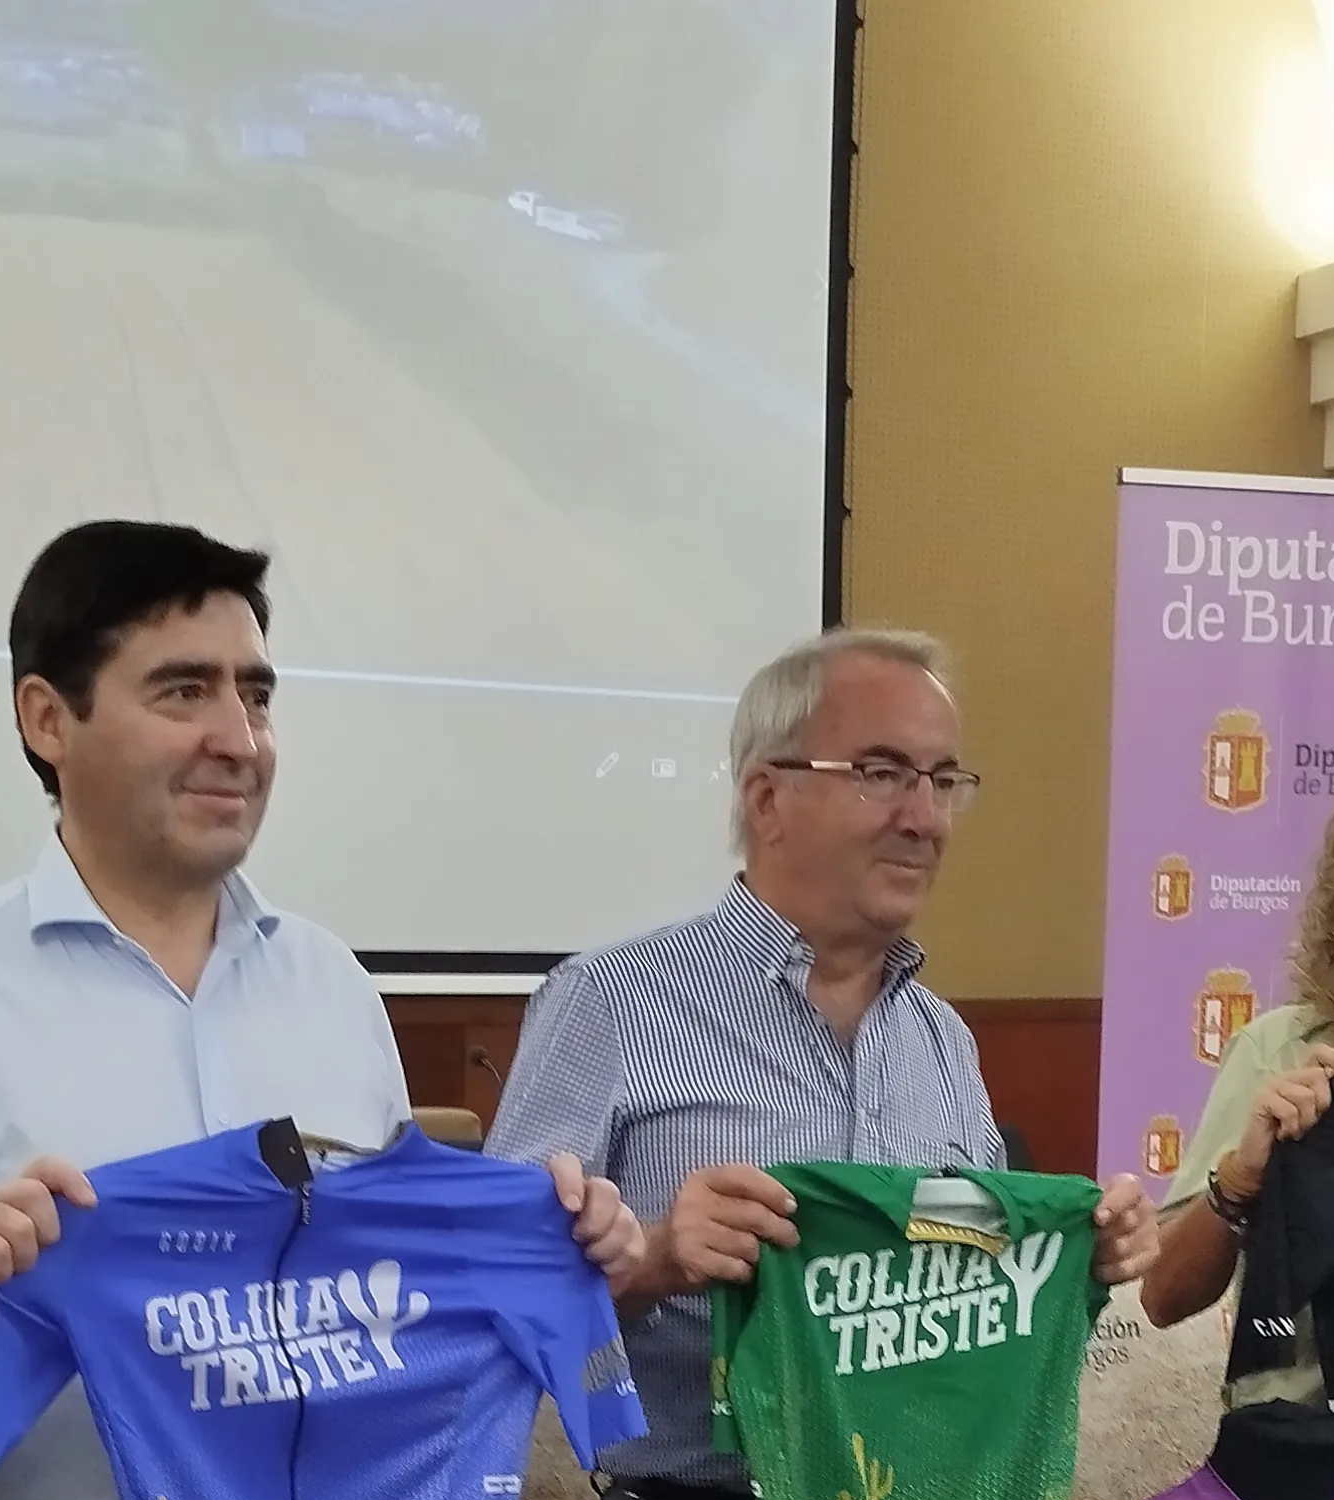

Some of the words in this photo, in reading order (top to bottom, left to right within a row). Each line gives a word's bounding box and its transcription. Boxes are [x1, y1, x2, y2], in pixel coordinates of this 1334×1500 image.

[1162, 585, 1224, 642] de
[1293, 771, 1321, 796] de
[1209, 892, 1229, 910] de
[1231, 893, 1289, 915] Burgos
[1210, 873, 1302, 896] Diputación
[804, 1243, 994, 1317] COLINA
[144, 1275, 345, 1357] COLINA
[829, 1284, 1009, 1377] TRISTE
[181, 1331, 376, 1412] TRISTE
